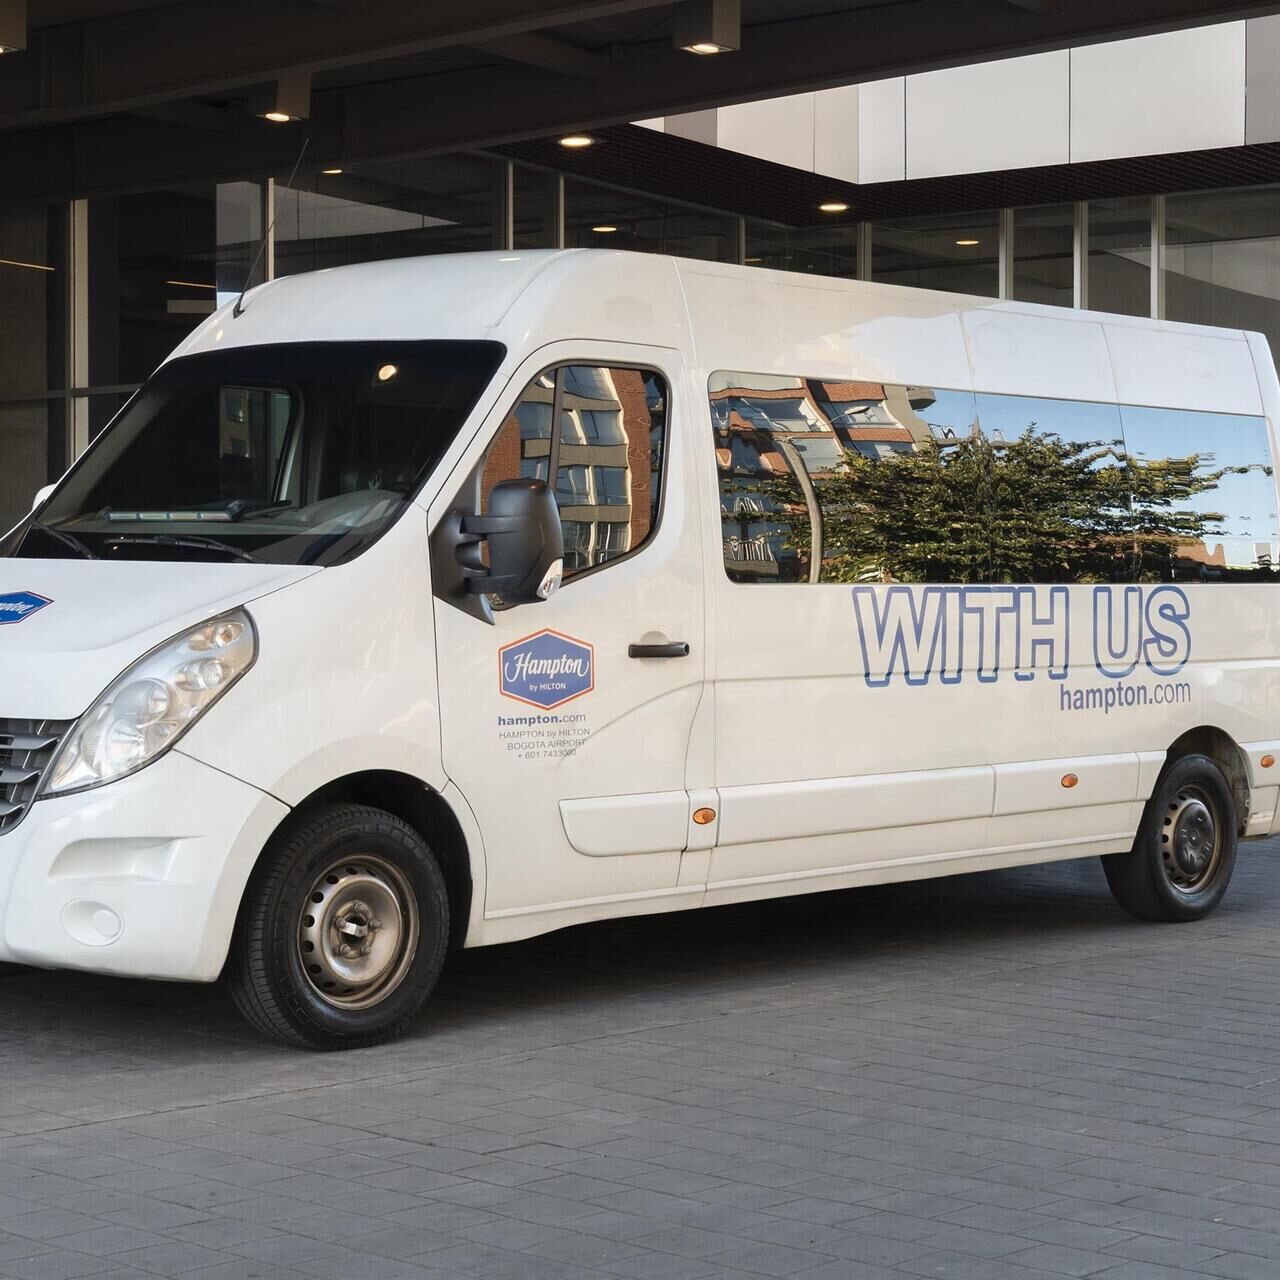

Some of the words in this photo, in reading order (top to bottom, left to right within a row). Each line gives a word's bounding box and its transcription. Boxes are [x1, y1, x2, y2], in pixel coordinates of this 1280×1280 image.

[852, 586, 1069, 687] WITH
[1093, 585, 1192, 678] US
[504, 651, 589, 682] Hampton
[529, 684, 538, 692] by
[539, 682, 566, 690] HILTON
[1060, 680, 1192, 714] hampton.com
[498, 714, 586, 726] hampton.com
[499, 730, 545, 739] HAMPTON
[547, 730, 557, 738] by
[558, 728, 591, 736] HILTON
[507, 740, 547, 751] BOGOTA
[548, 738, 586, 748] AIRPORT
[524, 751, 541, 759] 601
